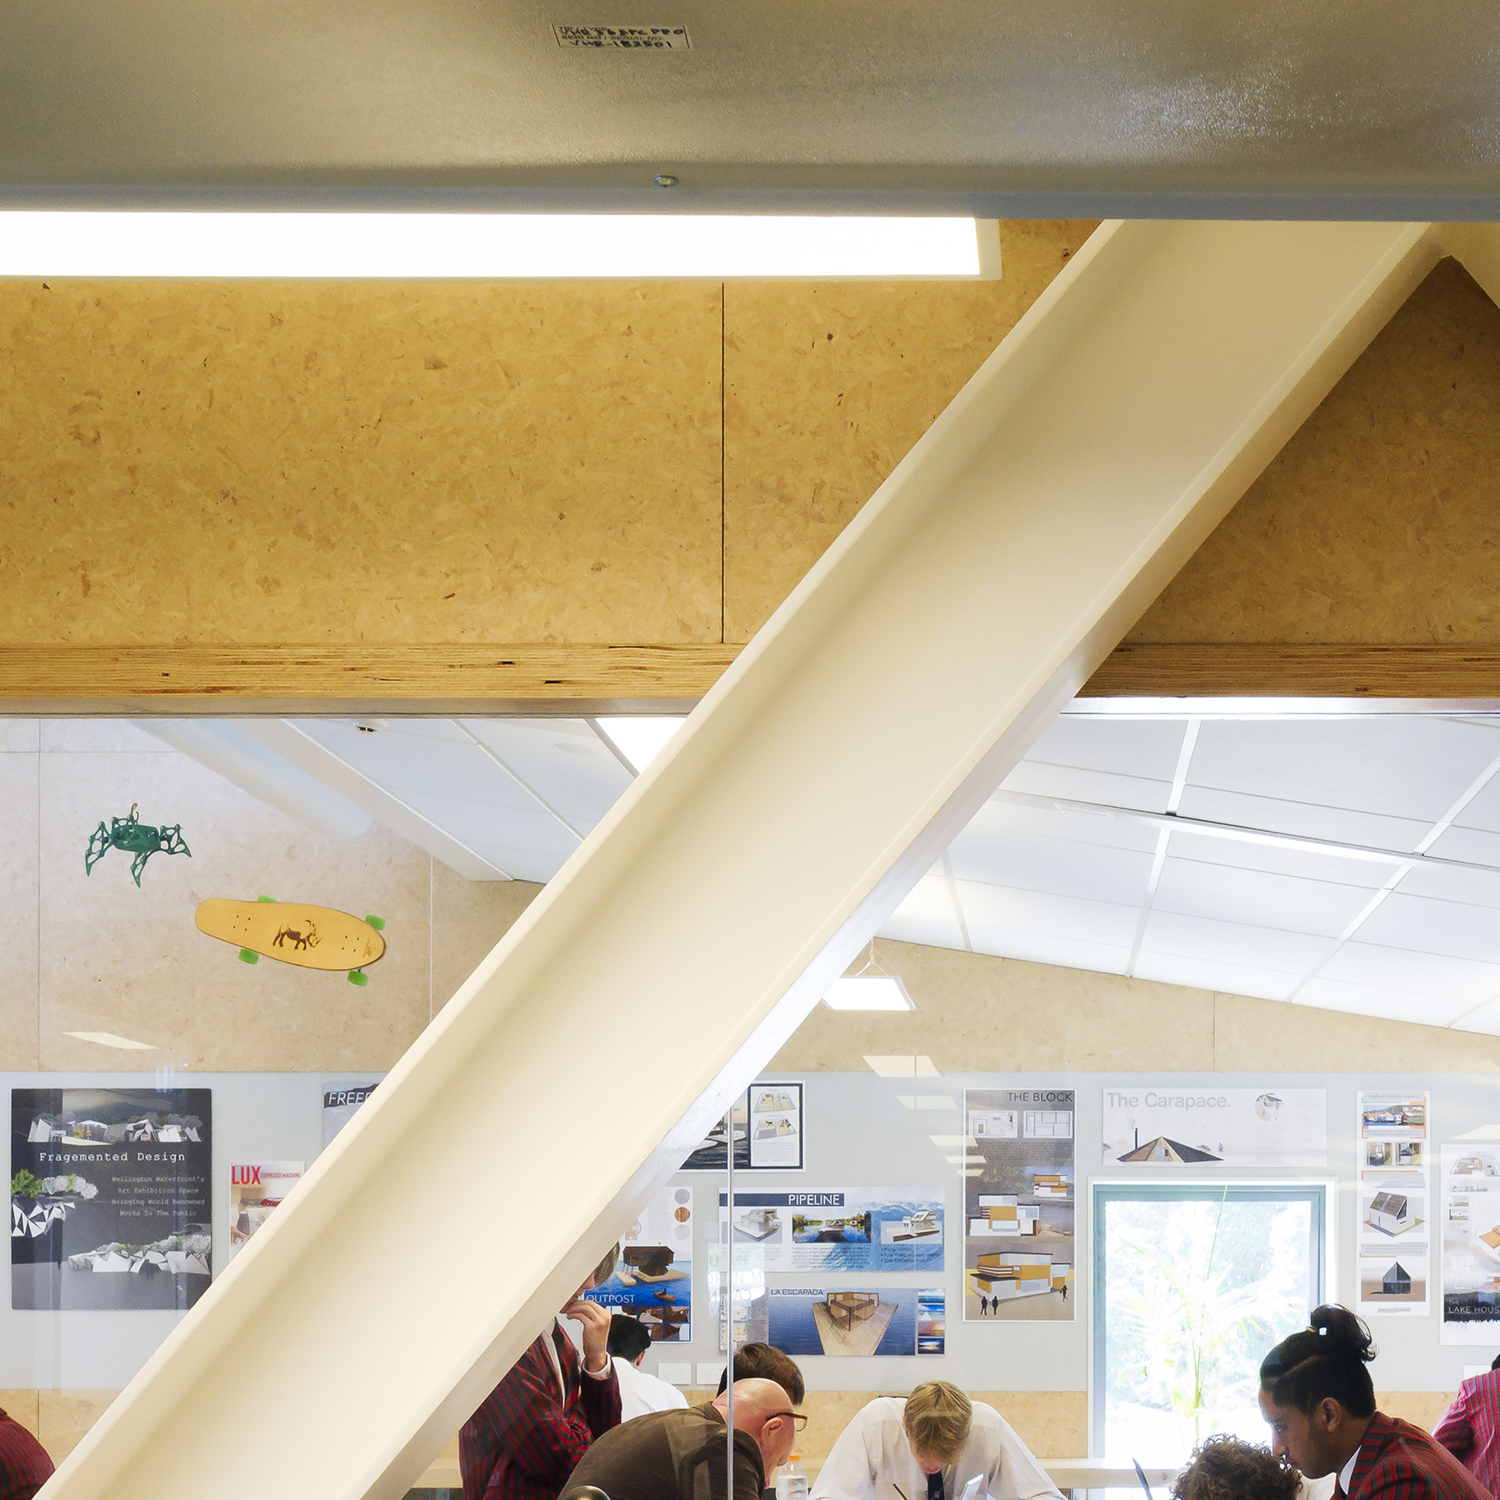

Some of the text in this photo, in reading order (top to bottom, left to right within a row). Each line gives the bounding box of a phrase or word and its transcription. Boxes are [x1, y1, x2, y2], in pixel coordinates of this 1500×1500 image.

[1007, 1092, 1073, 1102] THE BLOCK
[1107, 1092, 1231, 1111] The Carapace.
[39, 1152, 185, 1163] Fragemented Design
[112, 1176, 153, 1184] Wellington
[231, 1166, 261, 1185] LUX
[178, 1187, 199, 1195] Space
[788, 1194, 840, 1206] PIPELINE
[586, 1294, 635, 1304] OUTPOST
[1448, 1306, 1471, 1314] LAKE
